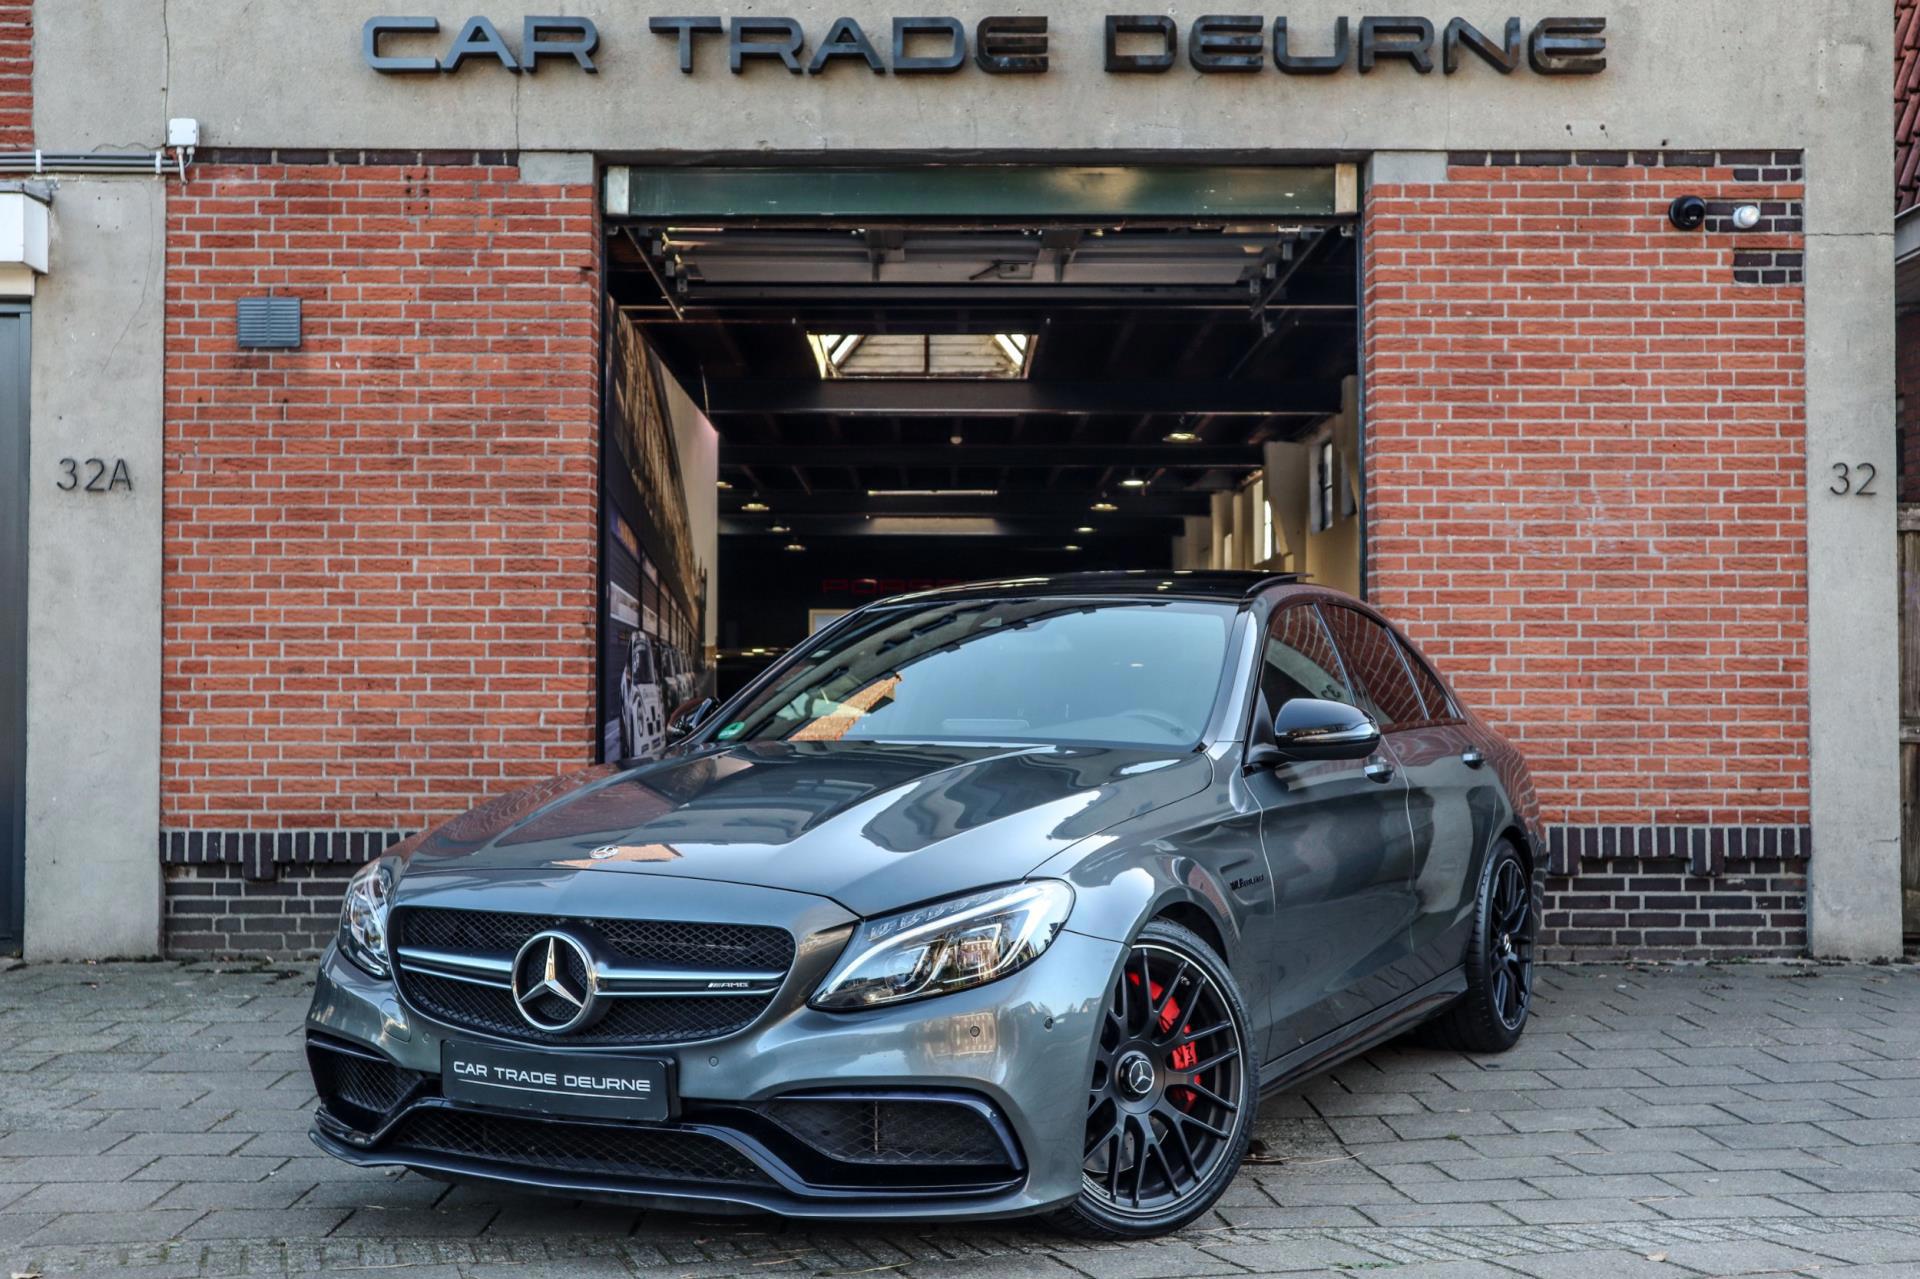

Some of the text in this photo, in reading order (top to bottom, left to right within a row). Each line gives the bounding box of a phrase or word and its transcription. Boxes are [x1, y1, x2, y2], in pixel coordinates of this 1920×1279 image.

[361, 14, 1608, 75] CAR TRADE DEURNE
[56, 457, 133, 493] 32A
[1829, 462, 1877, 496] 32
[453, 1061, 651, 1092] CAR TRADE DEURNE
